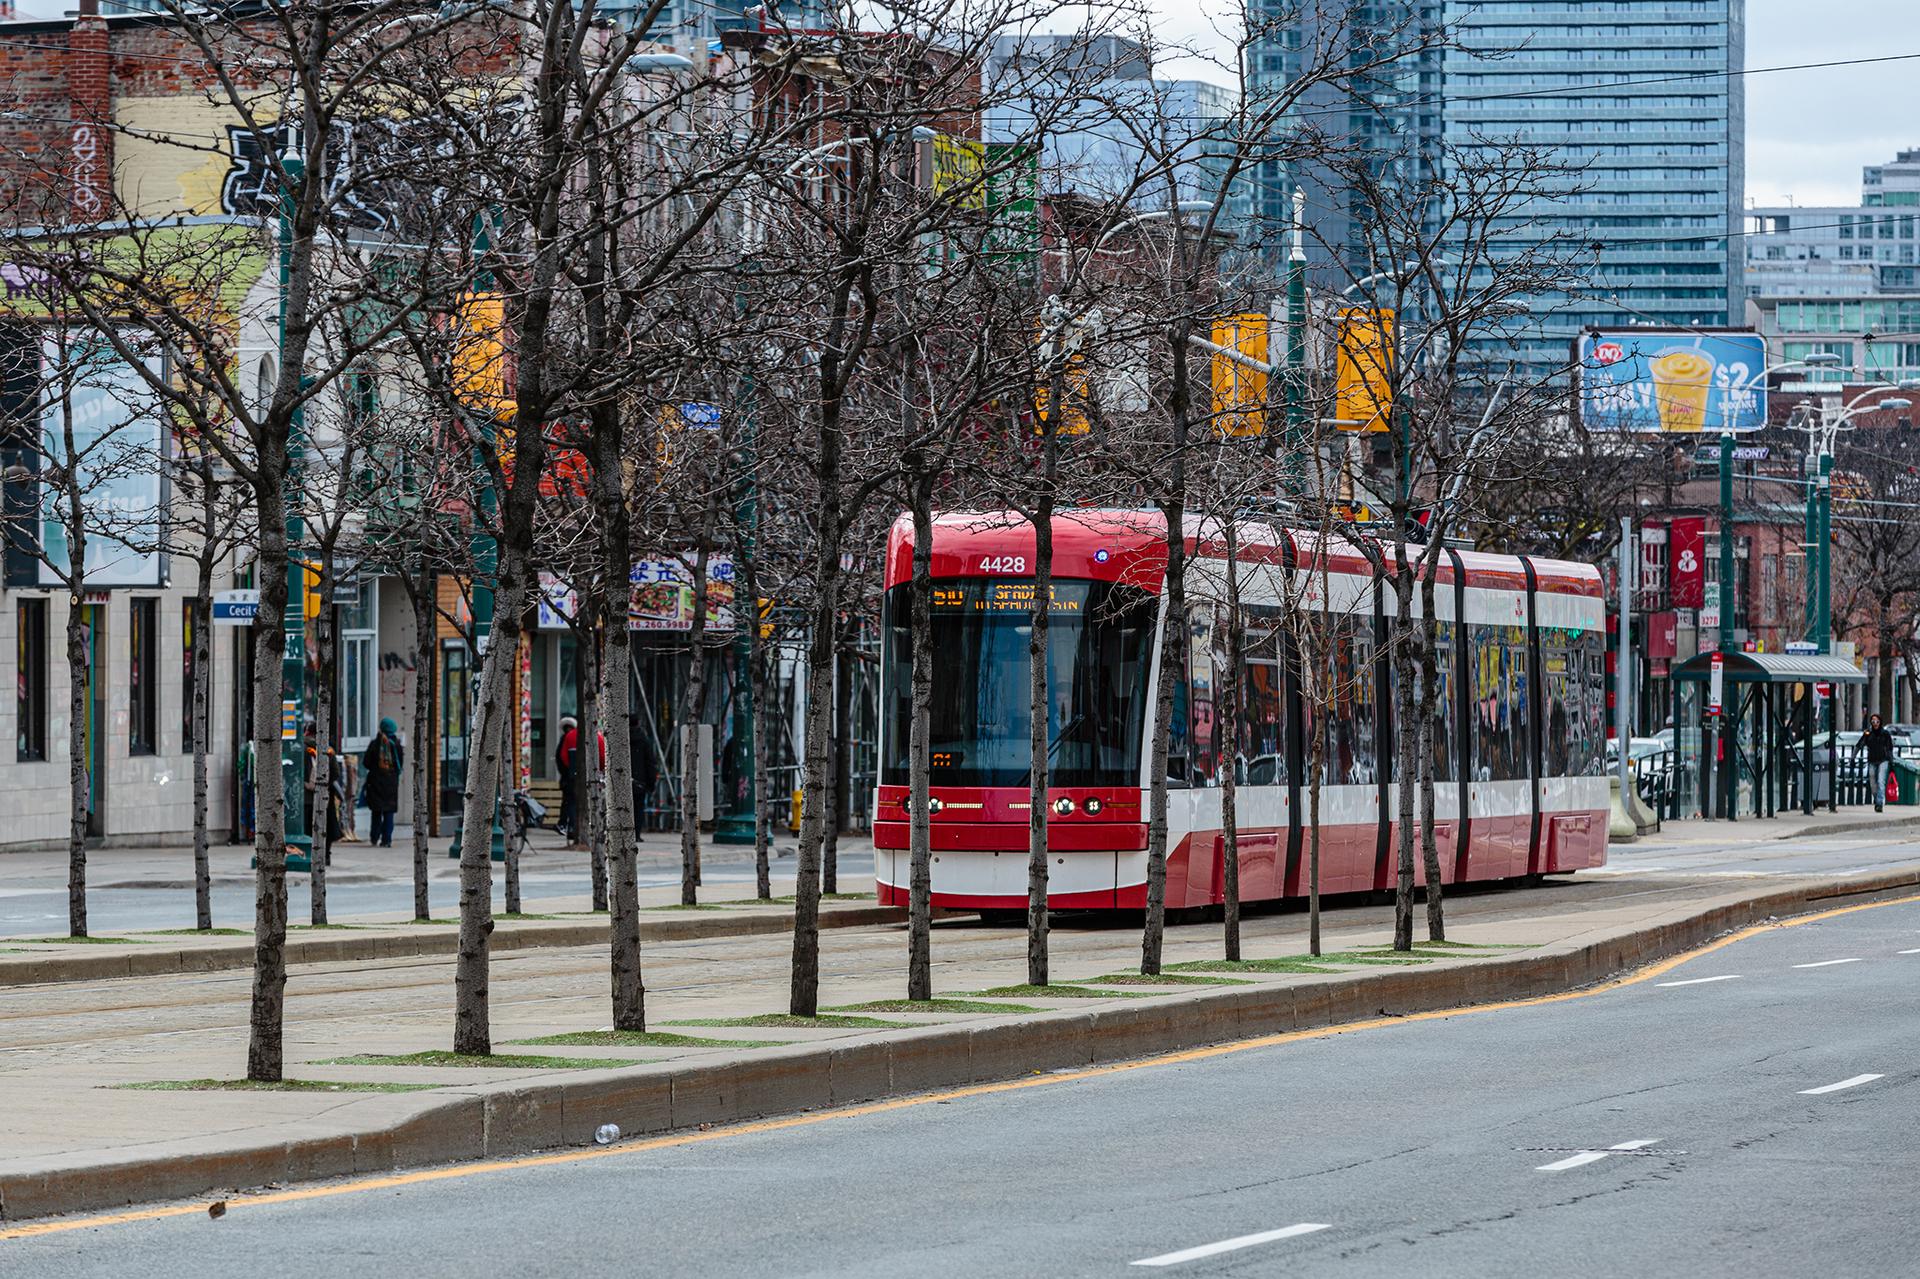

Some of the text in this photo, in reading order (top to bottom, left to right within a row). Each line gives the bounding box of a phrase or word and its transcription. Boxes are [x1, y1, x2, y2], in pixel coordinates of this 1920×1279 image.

[1710, 447, 1767, 459] OFRONT
[979, 556, 1026, 573] 4428
[86, 591, 109, 602] TM
[229, 605, 252, 616] Cecil
[630, 620, 690, 629] 16.260.9988
